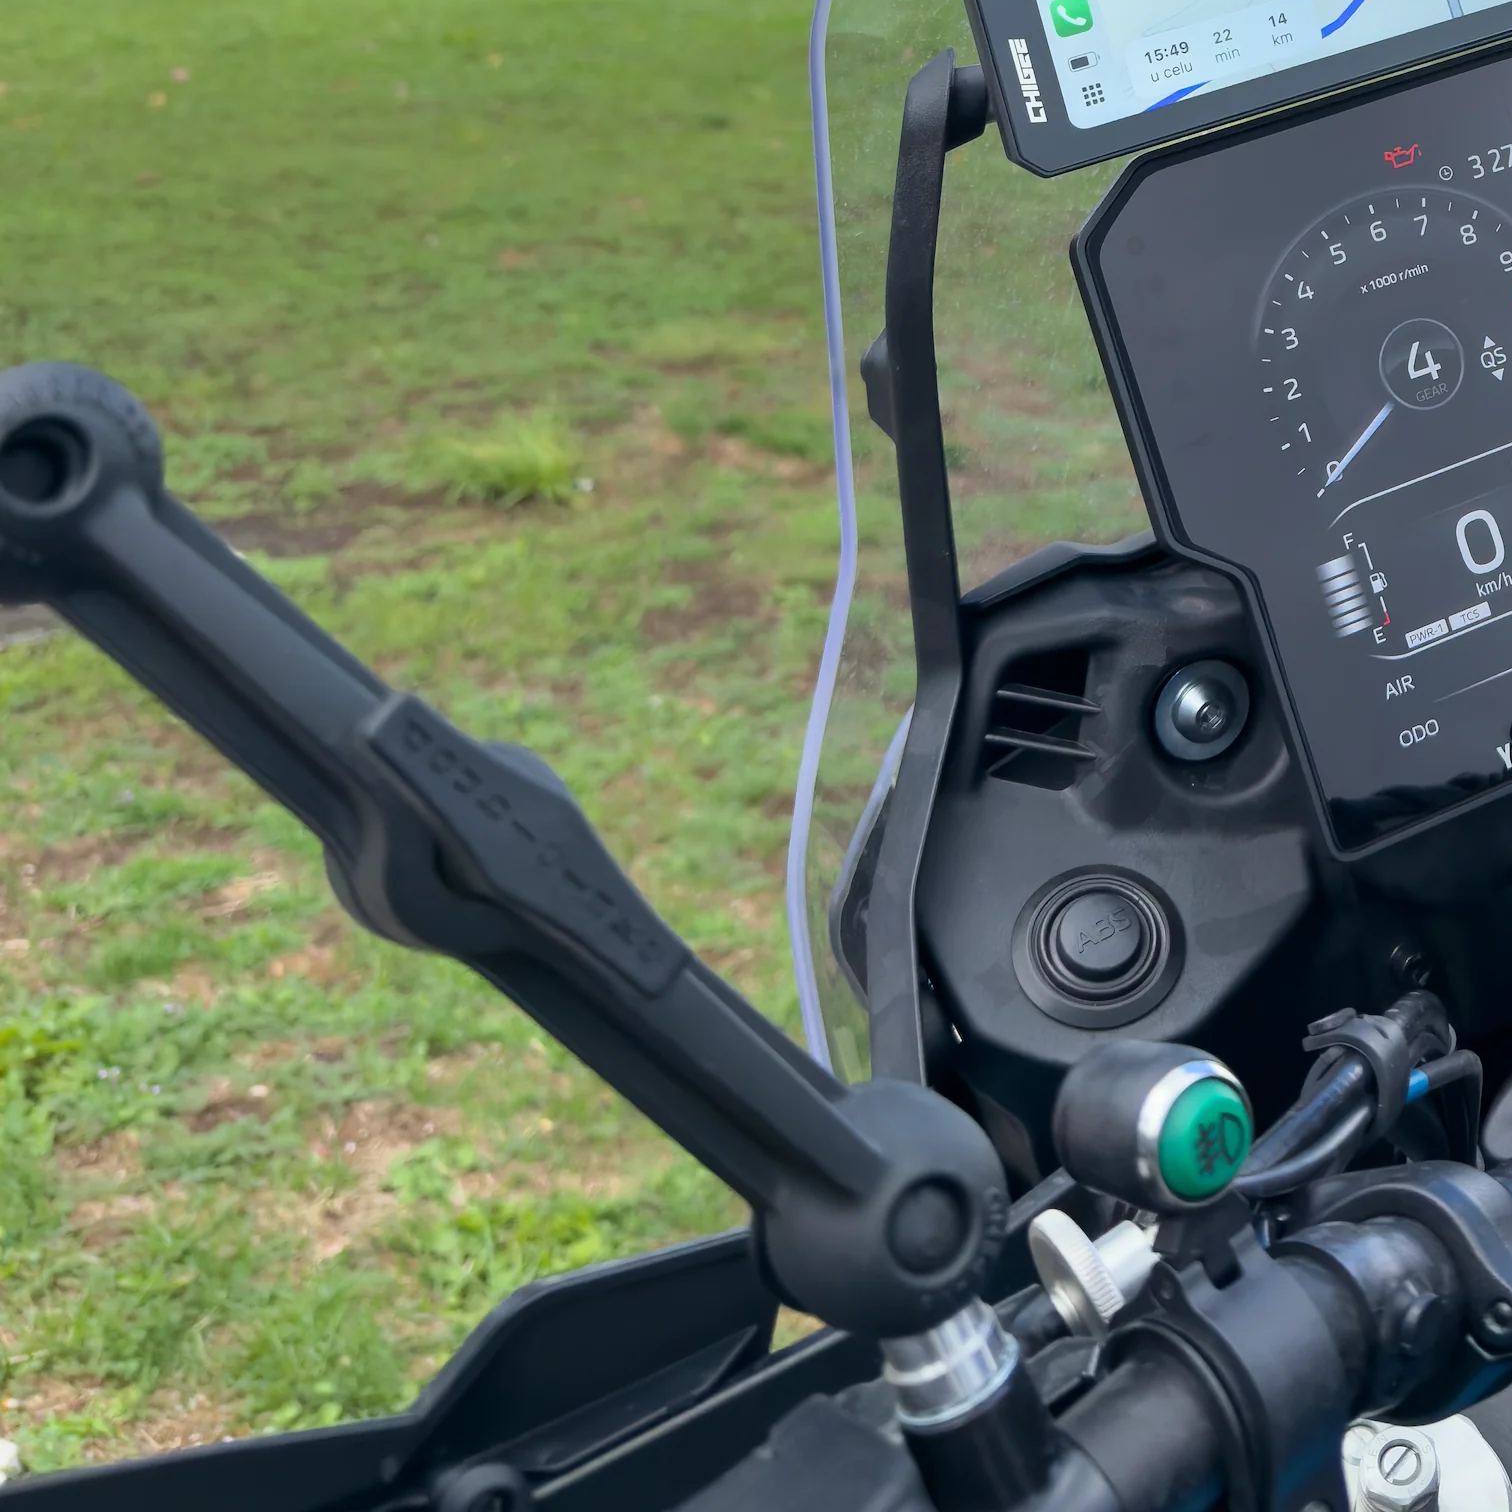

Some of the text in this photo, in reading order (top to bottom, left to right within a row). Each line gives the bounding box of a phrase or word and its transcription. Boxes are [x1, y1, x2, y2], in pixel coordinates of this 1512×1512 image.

[1268, 12, 1288, 28] 14
[1212, 28, 1233, 44] 22
[1271, 30, 1294, 46] km
[1144, 41, 1190, 64] 15:49
[1215, 47, 1241, 63] min
[1008, 38, 1048, 124] CHIGEE
[1150, 60, 1194, 83] u celu
[1369, 220, 1387, 242] 6
[1413, 214, 1429, 236] 7
[1459, 223, 1477, 246] 8
[1329, 242, 1347, 265] 5
[1398, 263, 1430, 282] r/min
[1297, 280, 1315, 301] 4
[1281, 327, 1299, 350] 3
[1407, 340, 1442, 381] 4
[1480, 346, 1508, 369] QS
[1284, 378, 1302, 401] 2
[1415, 381, 1449, 403] GEAR
[1298, 422, 1312, 443] 1
[1342, 532, 1355, 550] F
[1455, 509, 1506, 575] 0
[1460, 607, 1481, 624] TCS
[1372, 626, 1388, 645] E
[1408, 622, 1445, 646] PWR-1
[1385, 674, 1416, 700] AIR
[1399, 718, 1440, 748] ODO
[1076, 907, 1134, 956] ABS
